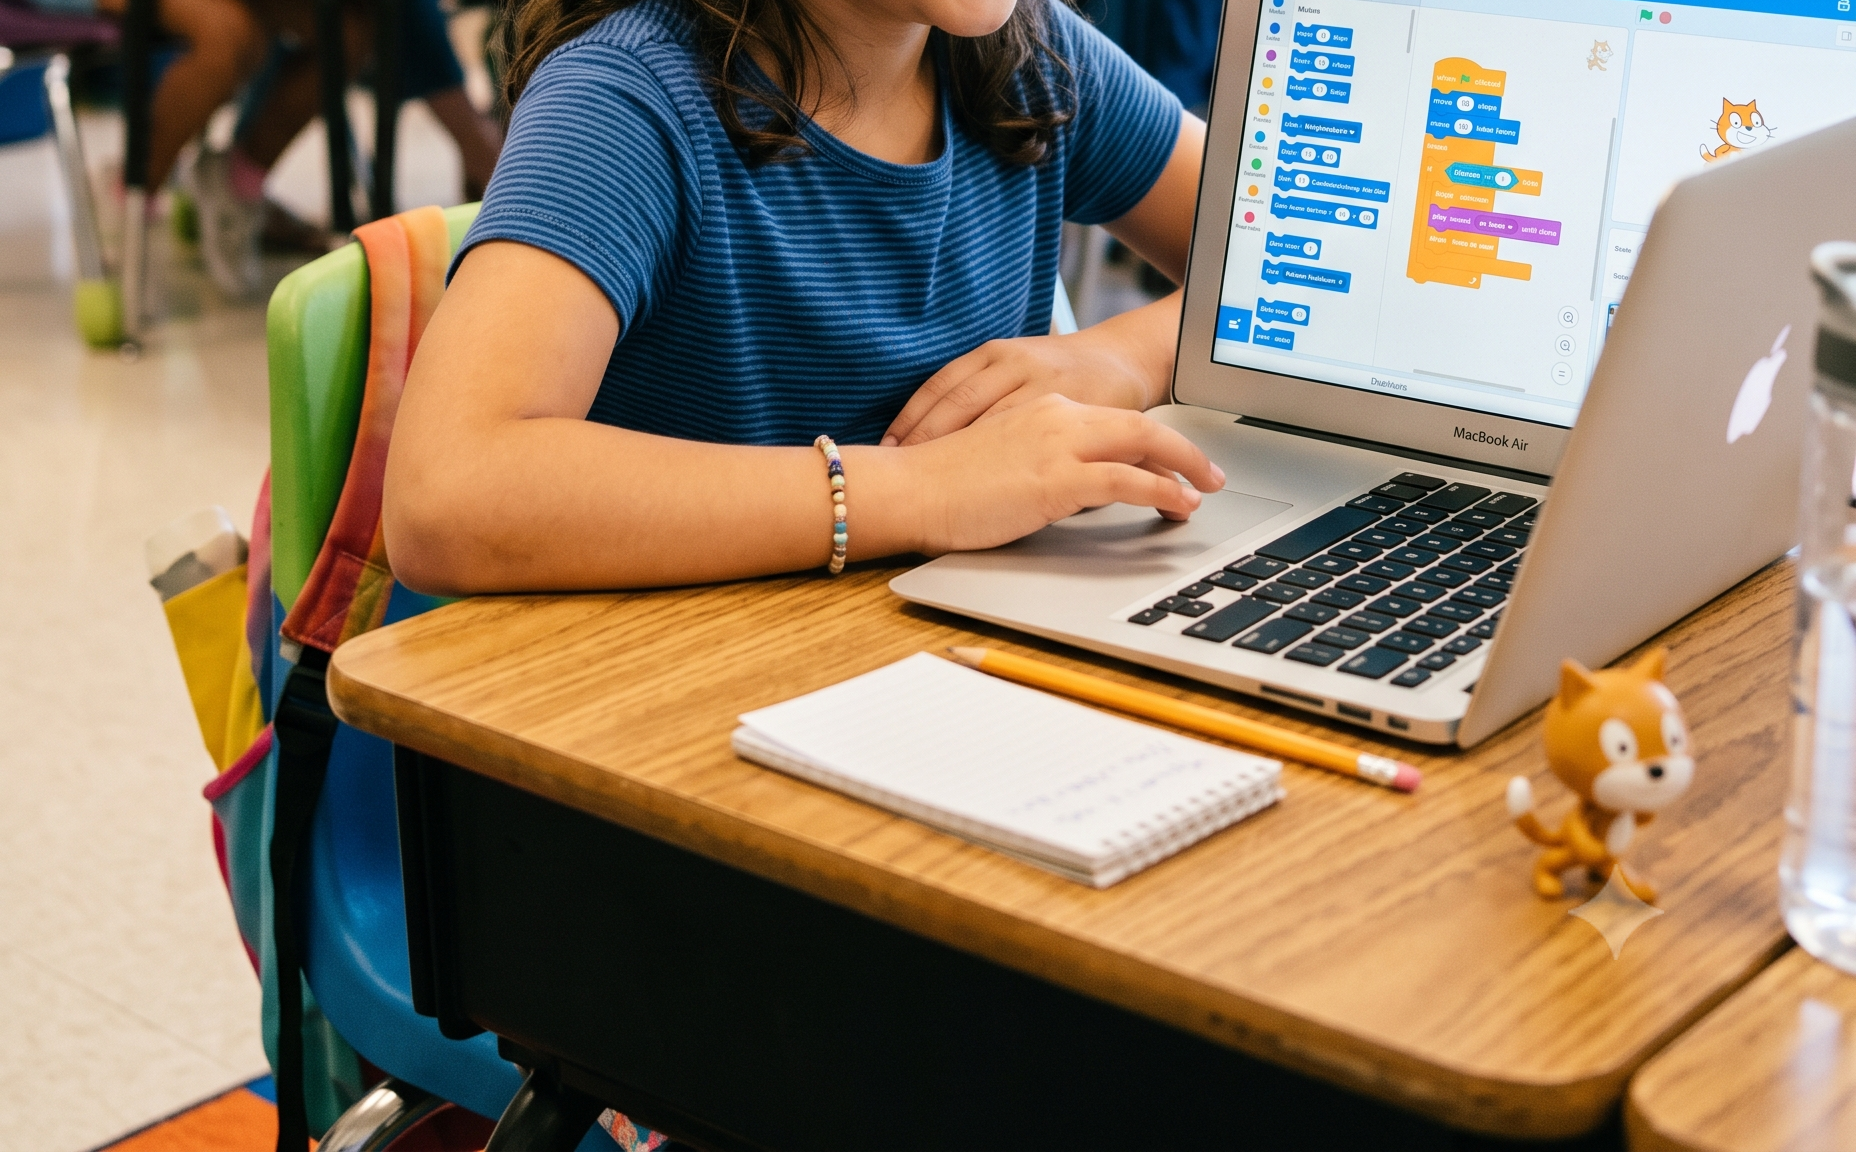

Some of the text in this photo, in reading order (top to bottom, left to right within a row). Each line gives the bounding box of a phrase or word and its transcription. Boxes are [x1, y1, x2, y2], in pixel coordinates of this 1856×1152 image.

[1433, 98, 1453, 106] move
[1453, 426, 1529, 451] MacBook Air
